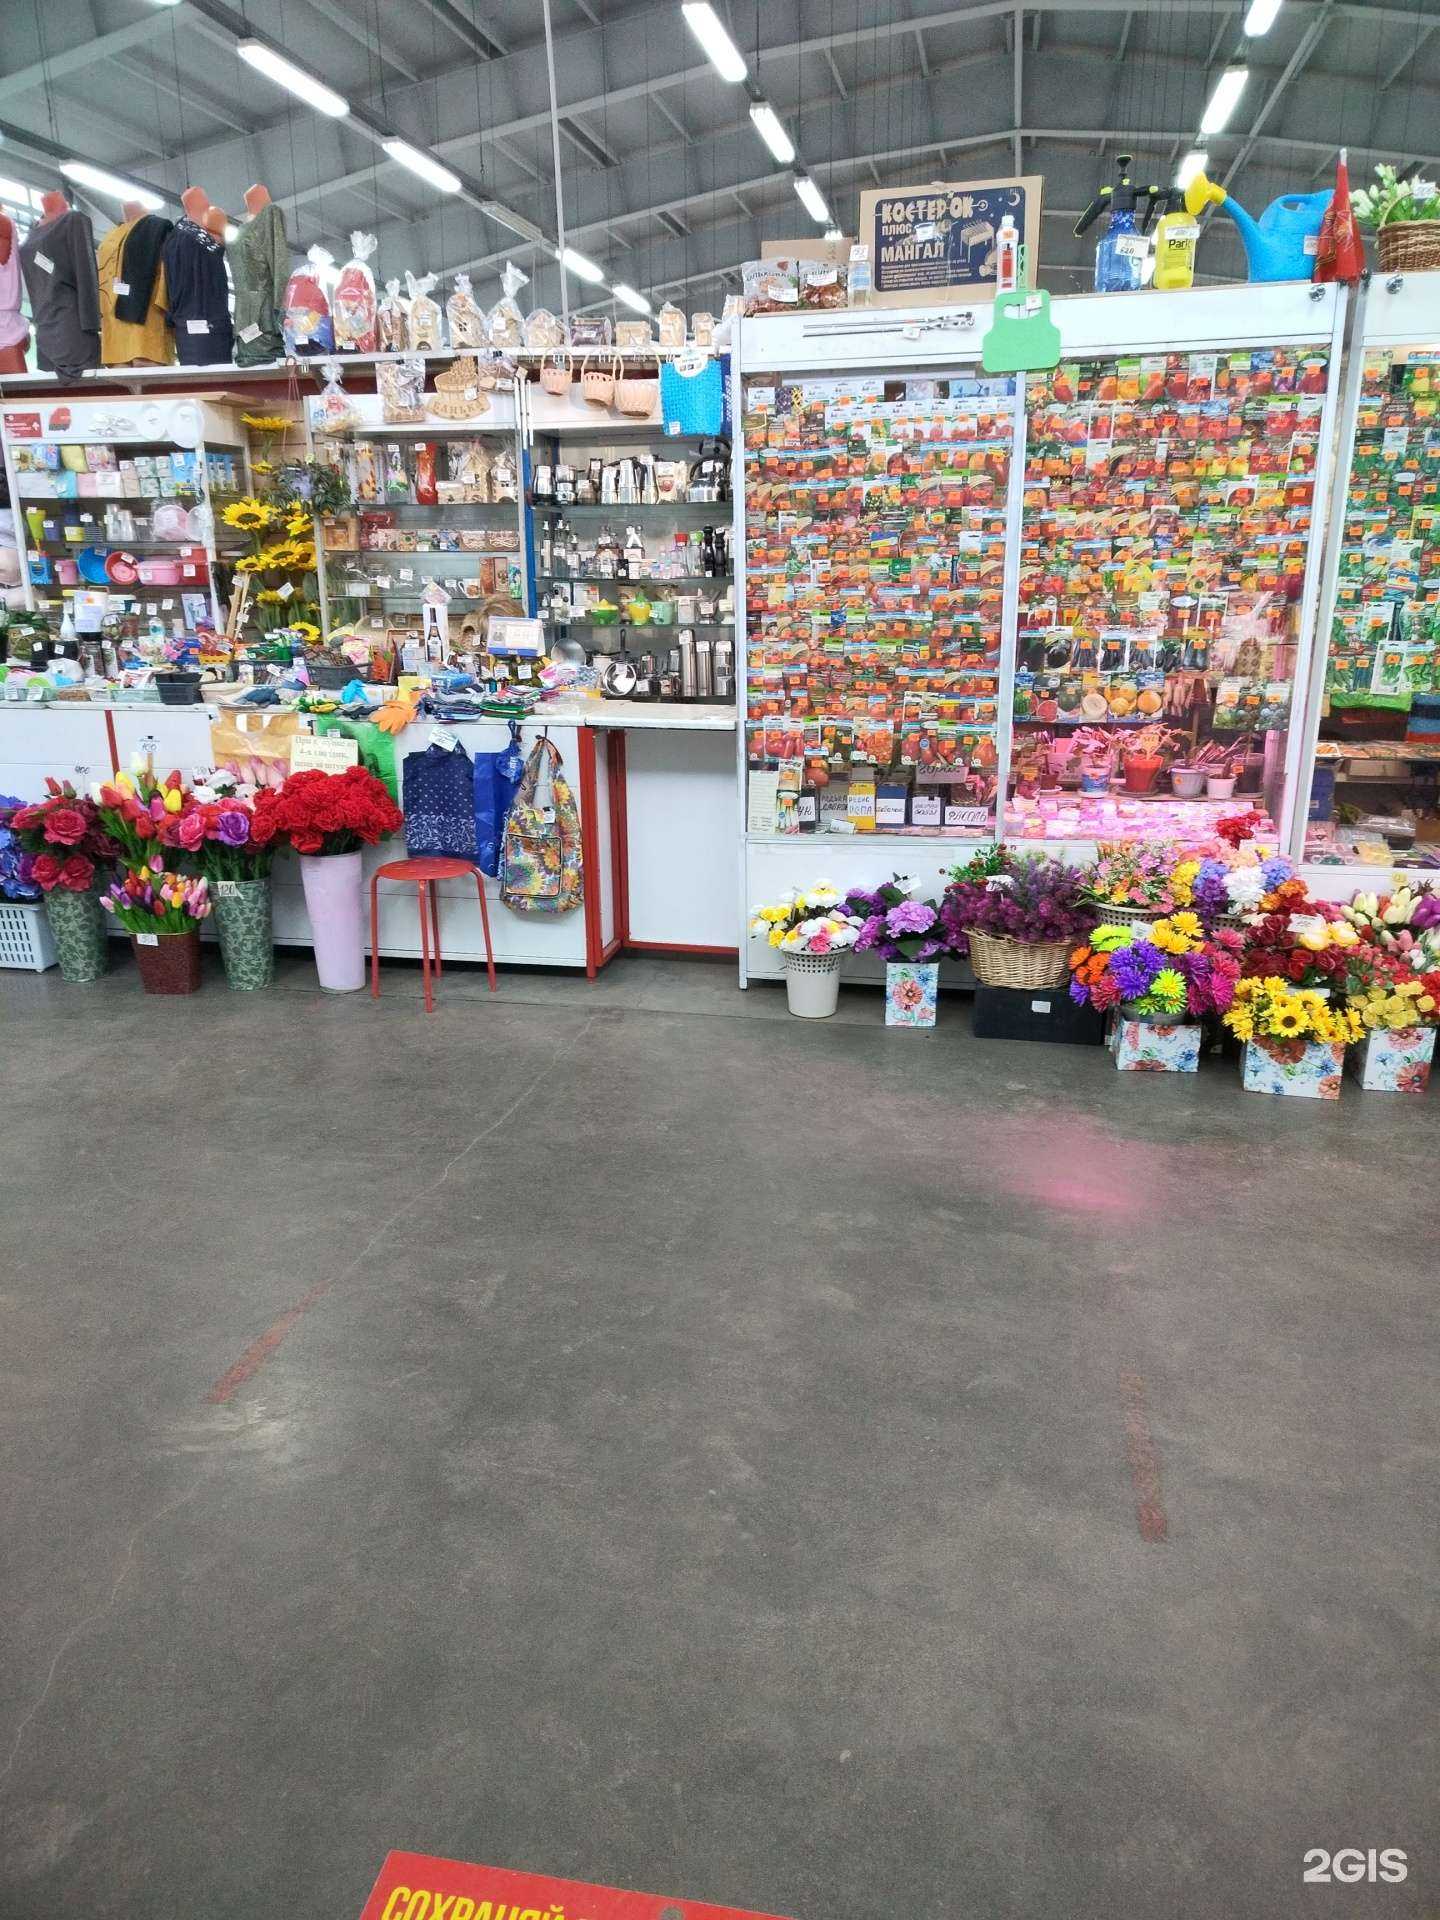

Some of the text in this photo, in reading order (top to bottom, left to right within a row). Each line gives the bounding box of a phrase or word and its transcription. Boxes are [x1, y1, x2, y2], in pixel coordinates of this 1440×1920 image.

[881, 223, 913, 236] ПЛЮС
[881, 242, 946, 263] МАНГАЛ
[380, 1886, 567, 1920] СОХРА
